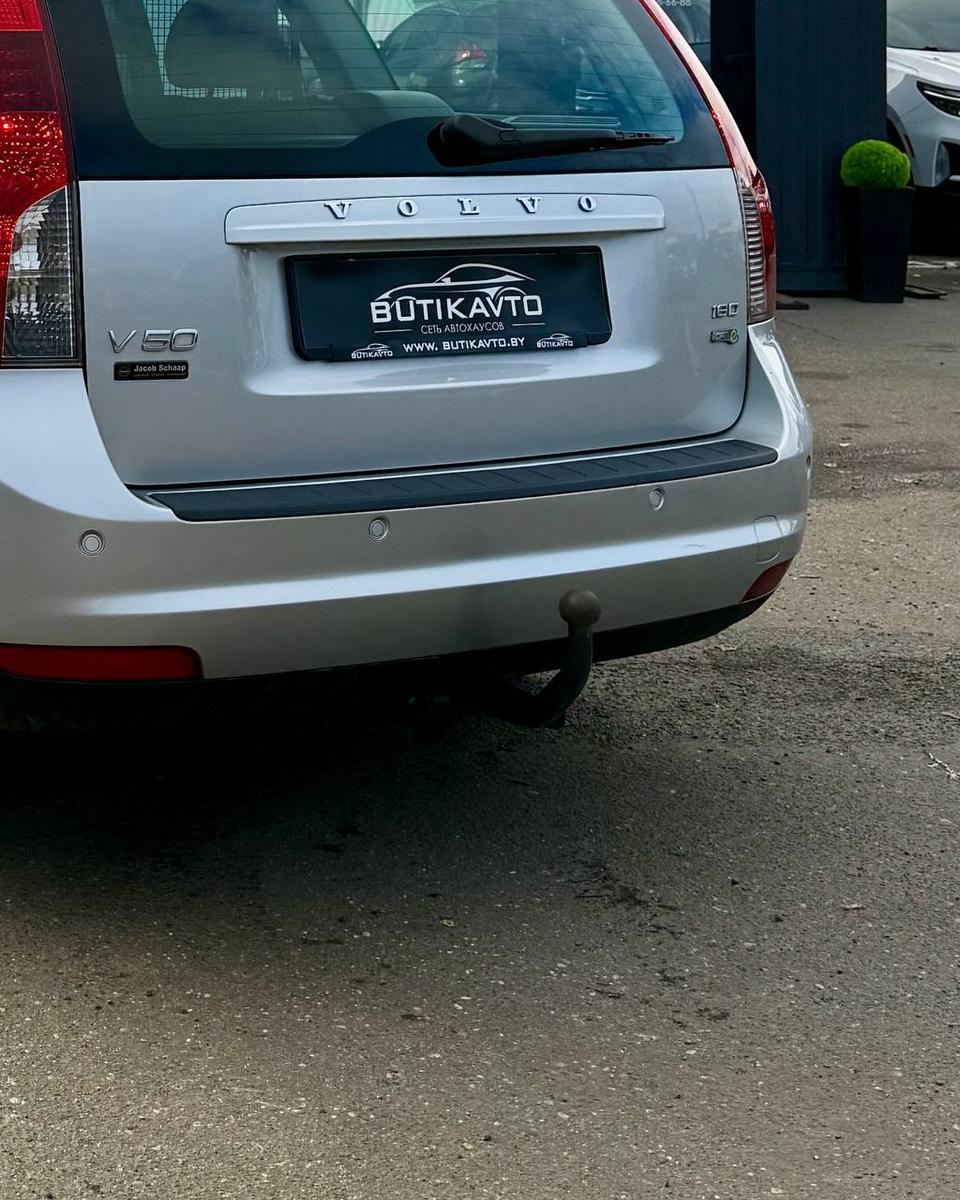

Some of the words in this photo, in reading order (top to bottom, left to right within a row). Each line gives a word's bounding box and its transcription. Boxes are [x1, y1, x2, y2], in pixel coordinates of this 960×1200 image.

[324, 195, 597, 220] VOLVO
[370, 295, 543, 324] BUTIKAVTO
[420, 325, 442, 335] СЕТЬ
[444, 321, 505, 333] АВТОХАУСОВ
[403, 342, 439, 353] WWW.
[442, 337, 525, 351] BUTIKAVTO.BY
[536, 340, 574, 348] BUTIKAVTO
[351, 350, 393, 359] BUTIKAVTO
[158, 364, 187, 372] Schaap
